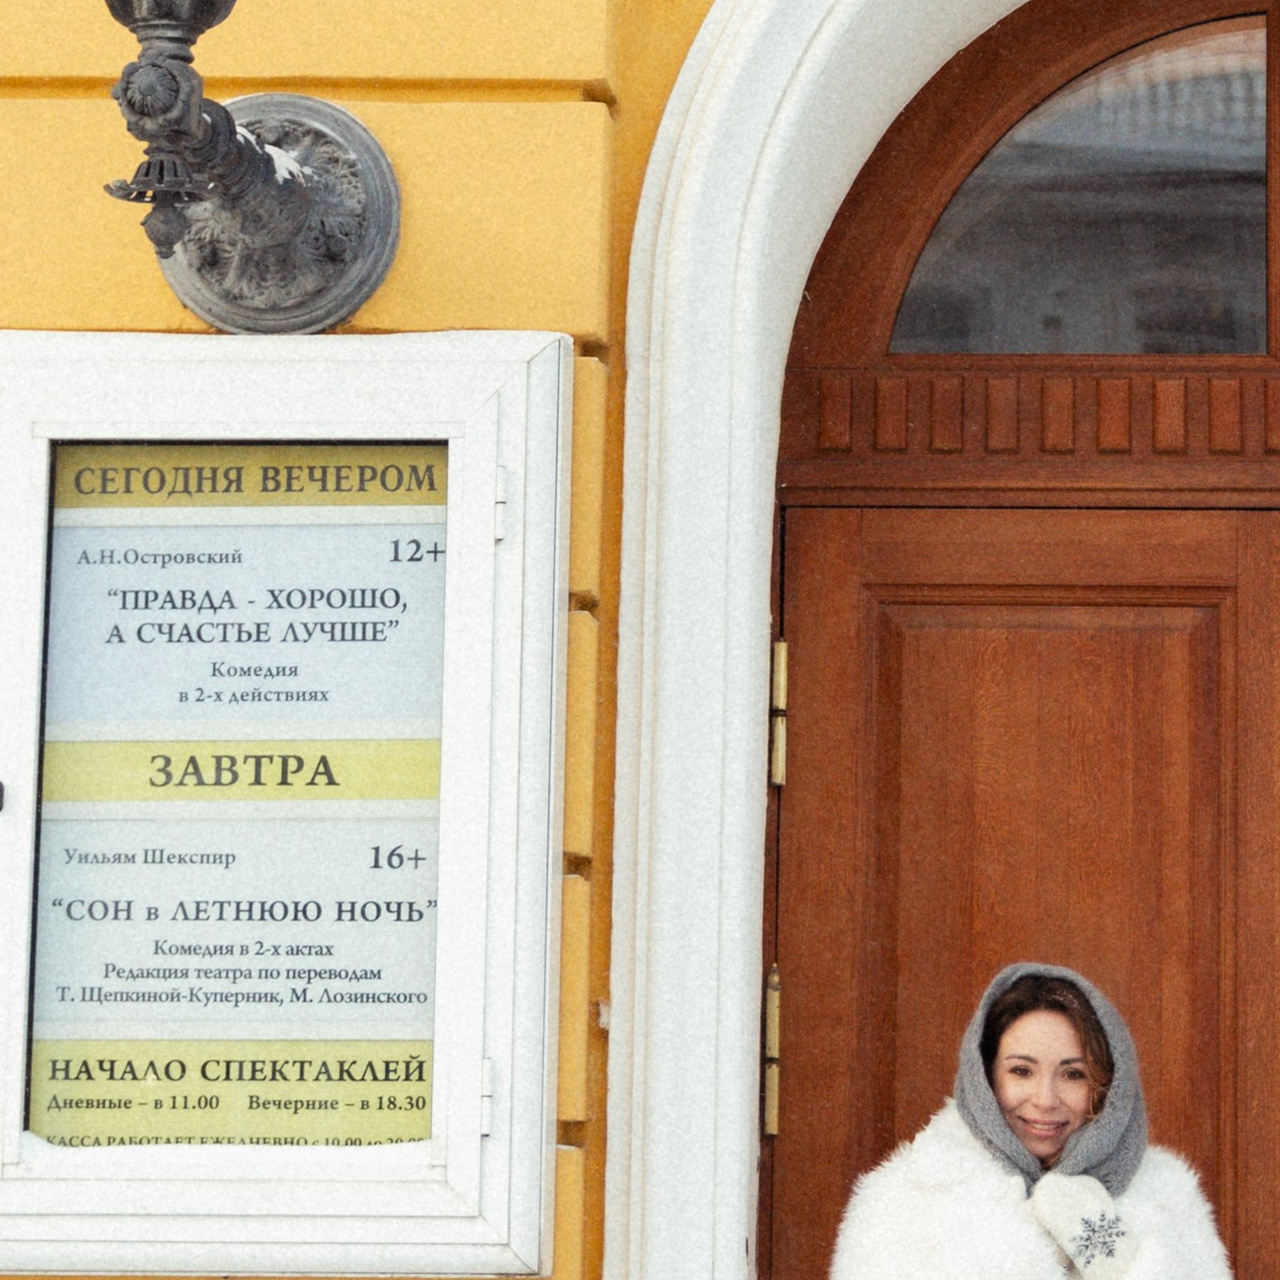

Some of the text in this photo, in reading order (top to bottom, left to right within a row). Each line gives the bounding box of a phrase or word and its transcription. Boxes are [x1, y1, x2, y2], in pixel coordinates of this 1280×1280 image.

[74, 463, 438, 498] СЕГОДНЯ ВЕЧЕРОМ
[76, 549, 242, 569] А.Н.Островский
[391, 538, 446, 563] 12+
[107, 589, 236, 614] “ПРАВДА
[266, 588, 407, 613] ХОРОШО,
[105, 619, 400, 644] А СЧАСТЬЕ ЛУЧШЕ”
[211, 661, 298, 679] Комедия
[178, 687, 329, 704] в 2-х действиях
[149, 754, 340, 788] ЗАВТРА
[63, 848, 236, 870] Уильям Шекспир
[371, 845, 426, 870] 16+
[51, 898, 133, 921] “СОН
[145, 906, 160, 921] в
[171, 900, 323, 922] ЛЕТНЮЮ
[153, 939, 334, 958] Комедия в 2-х актах
[103, 963, 382, 985] Редакция театра по переводам
[56, 986, 428, 1008] Т. Щепкиной-Куперник, М. Лозинского
[49, 1055, 426, 1082] НАЧАЛО СПЕКТАКЛЕЙ
[46, 1094, 133, 1112] Дневные
[153, 1098, 164, 1110] в
[170, 1095, 220, 1110] 11.00
[248, 1094, 339, 1115] Вечерние
[360, 1099, 370, 1111] в
[377, 1095, 427, 1111] 18.30
